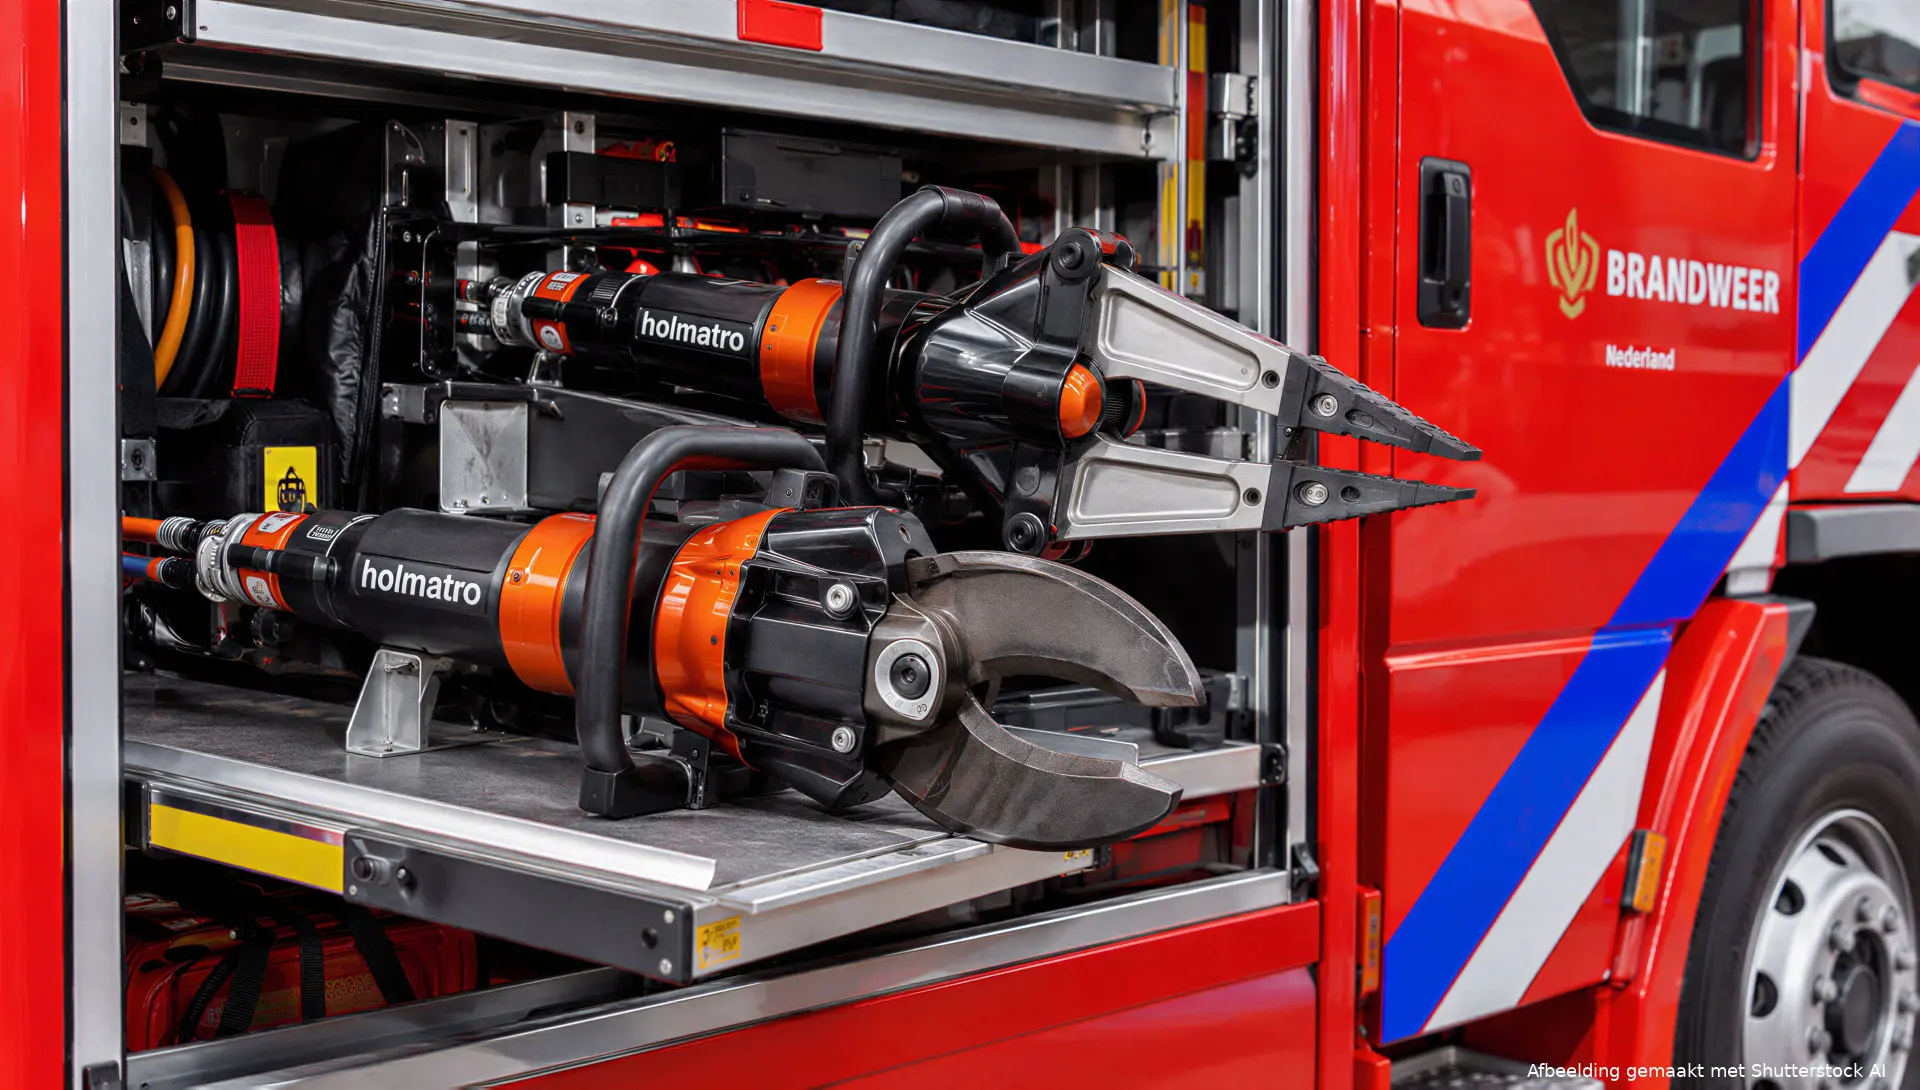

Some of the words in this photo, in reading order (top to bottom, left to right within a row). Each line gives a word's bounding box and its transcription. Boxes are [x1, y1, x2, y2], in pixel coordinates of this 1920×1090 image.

[1607, 249, 1780, 314] BRANDWEER
[641, 310, 744, 352] holmatro
[1605, 344, 1676, 371] Nederland
[361, 559, 481, 606] holmatro
